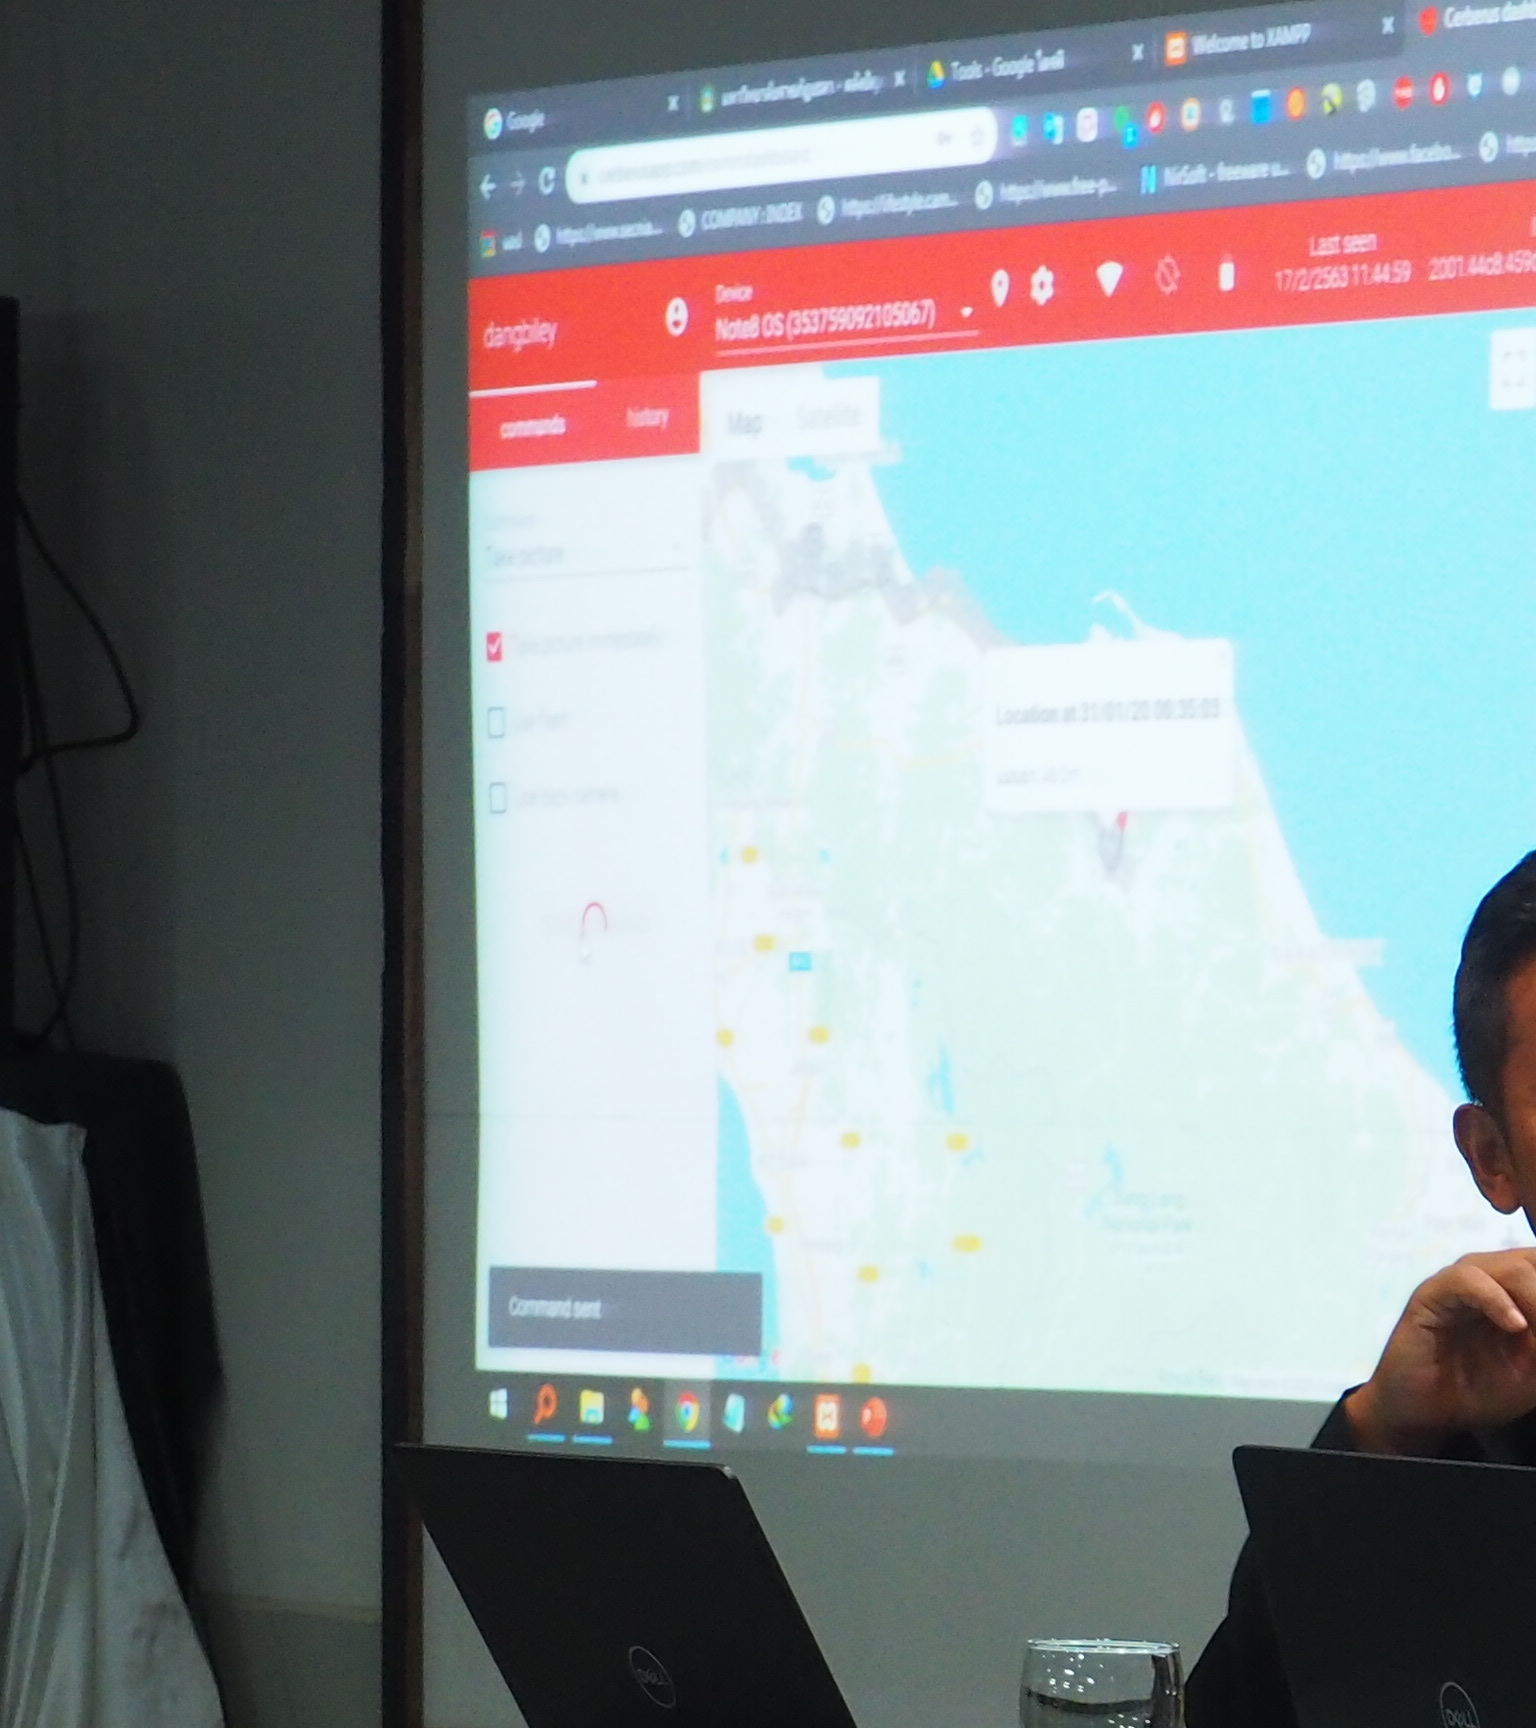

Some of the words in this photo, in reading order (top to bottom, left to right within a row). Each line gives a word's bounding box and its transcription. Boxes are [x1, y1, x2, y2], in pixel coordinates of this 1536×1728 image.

[506, 110, 545, 133] Google
[1309, 234, 1341, 257] Last
[1343, 232, 1378, 254] seen
